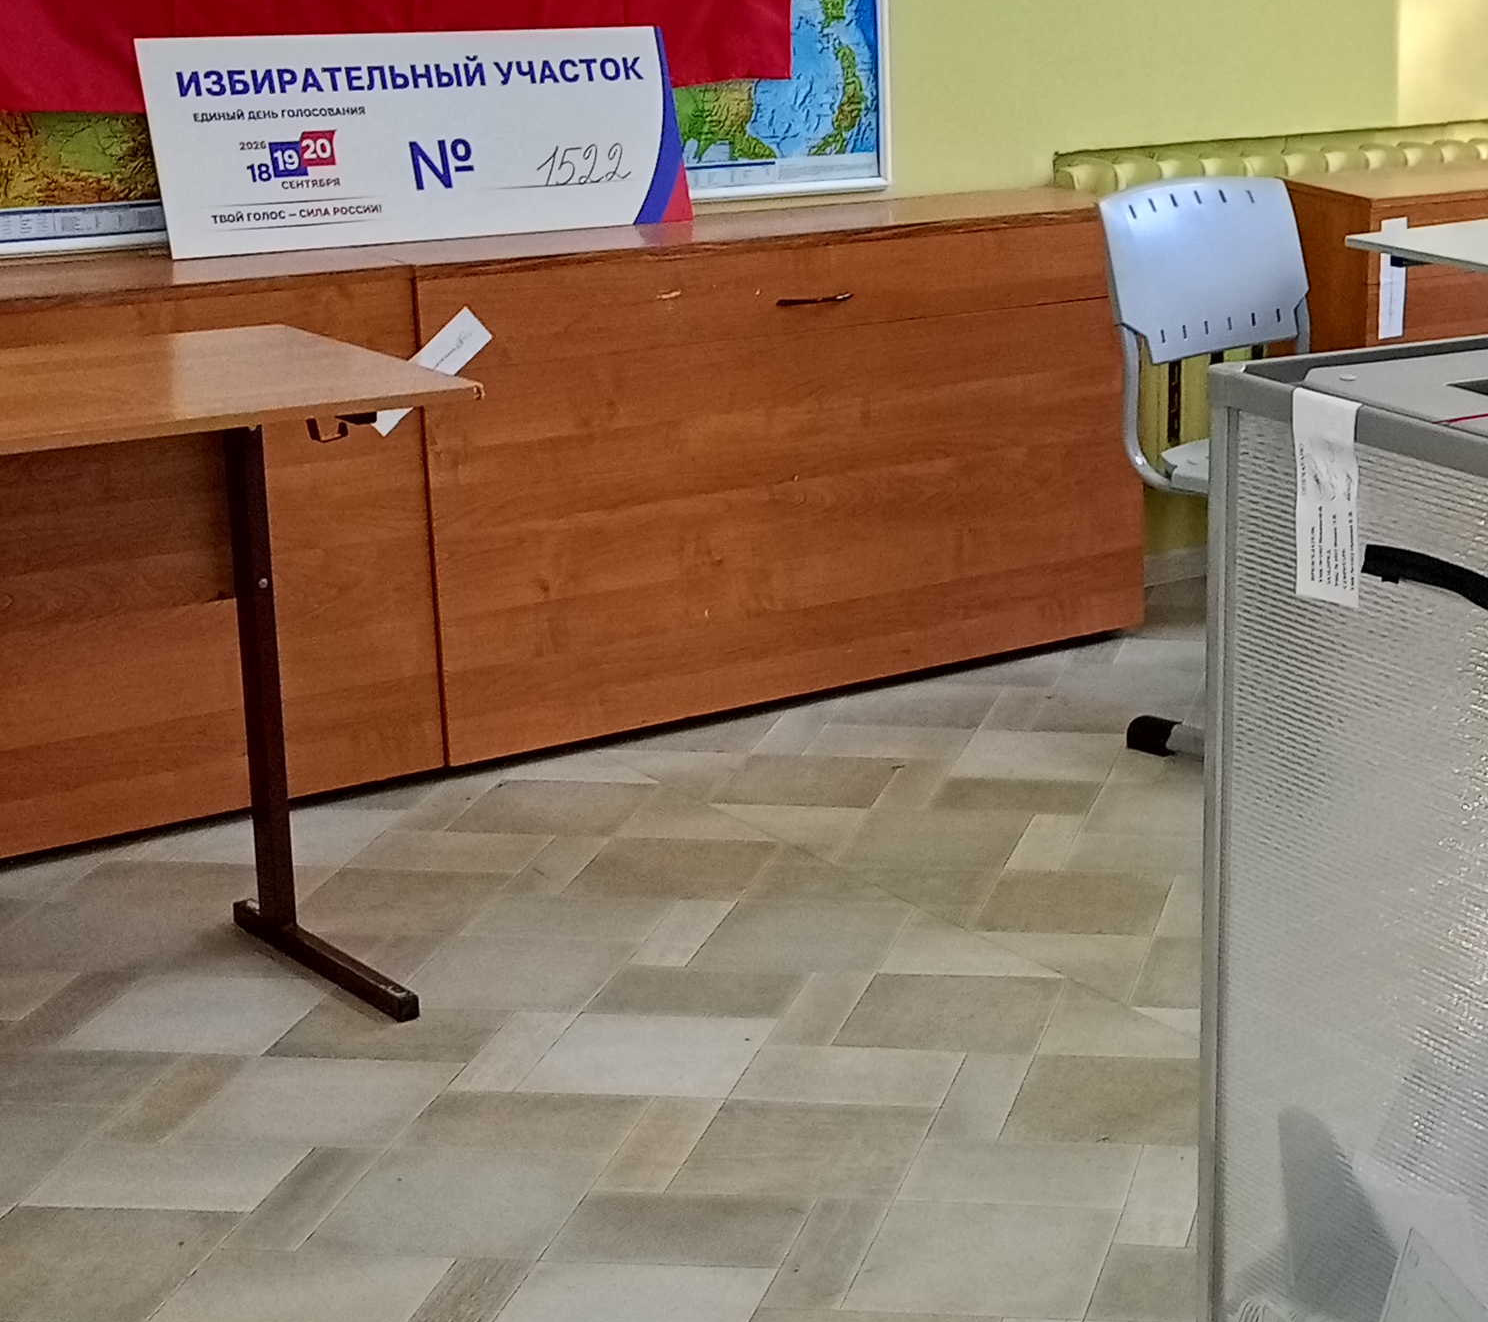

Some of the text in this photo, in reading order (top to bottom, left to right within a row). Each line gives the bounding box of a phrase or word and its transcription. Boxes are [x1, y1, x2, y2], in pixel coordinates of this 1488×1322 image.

[176, 56, 644, 97] ИЗБИРАТЕЛЬНЫЙ УЧАСТОК
[193, 106, 366, 123] ЕДИНЫЙ ДЕНЬ ГОЛОСОВАНИЯ
[246, 138, 332, 183] 18 19 20
[408, 138, 474, 191] №
[536, 142, 632, 187] 1522
[281, 177, 341, 190] СЕНТЯБРЯ
[211, 211, 244, 224] ТВОЙ
[246, 209, 286, 222] ГОЛОС
[299, 208, 330, 218] СИЛА
[333, 204, 382, 216] РОССИИ!
